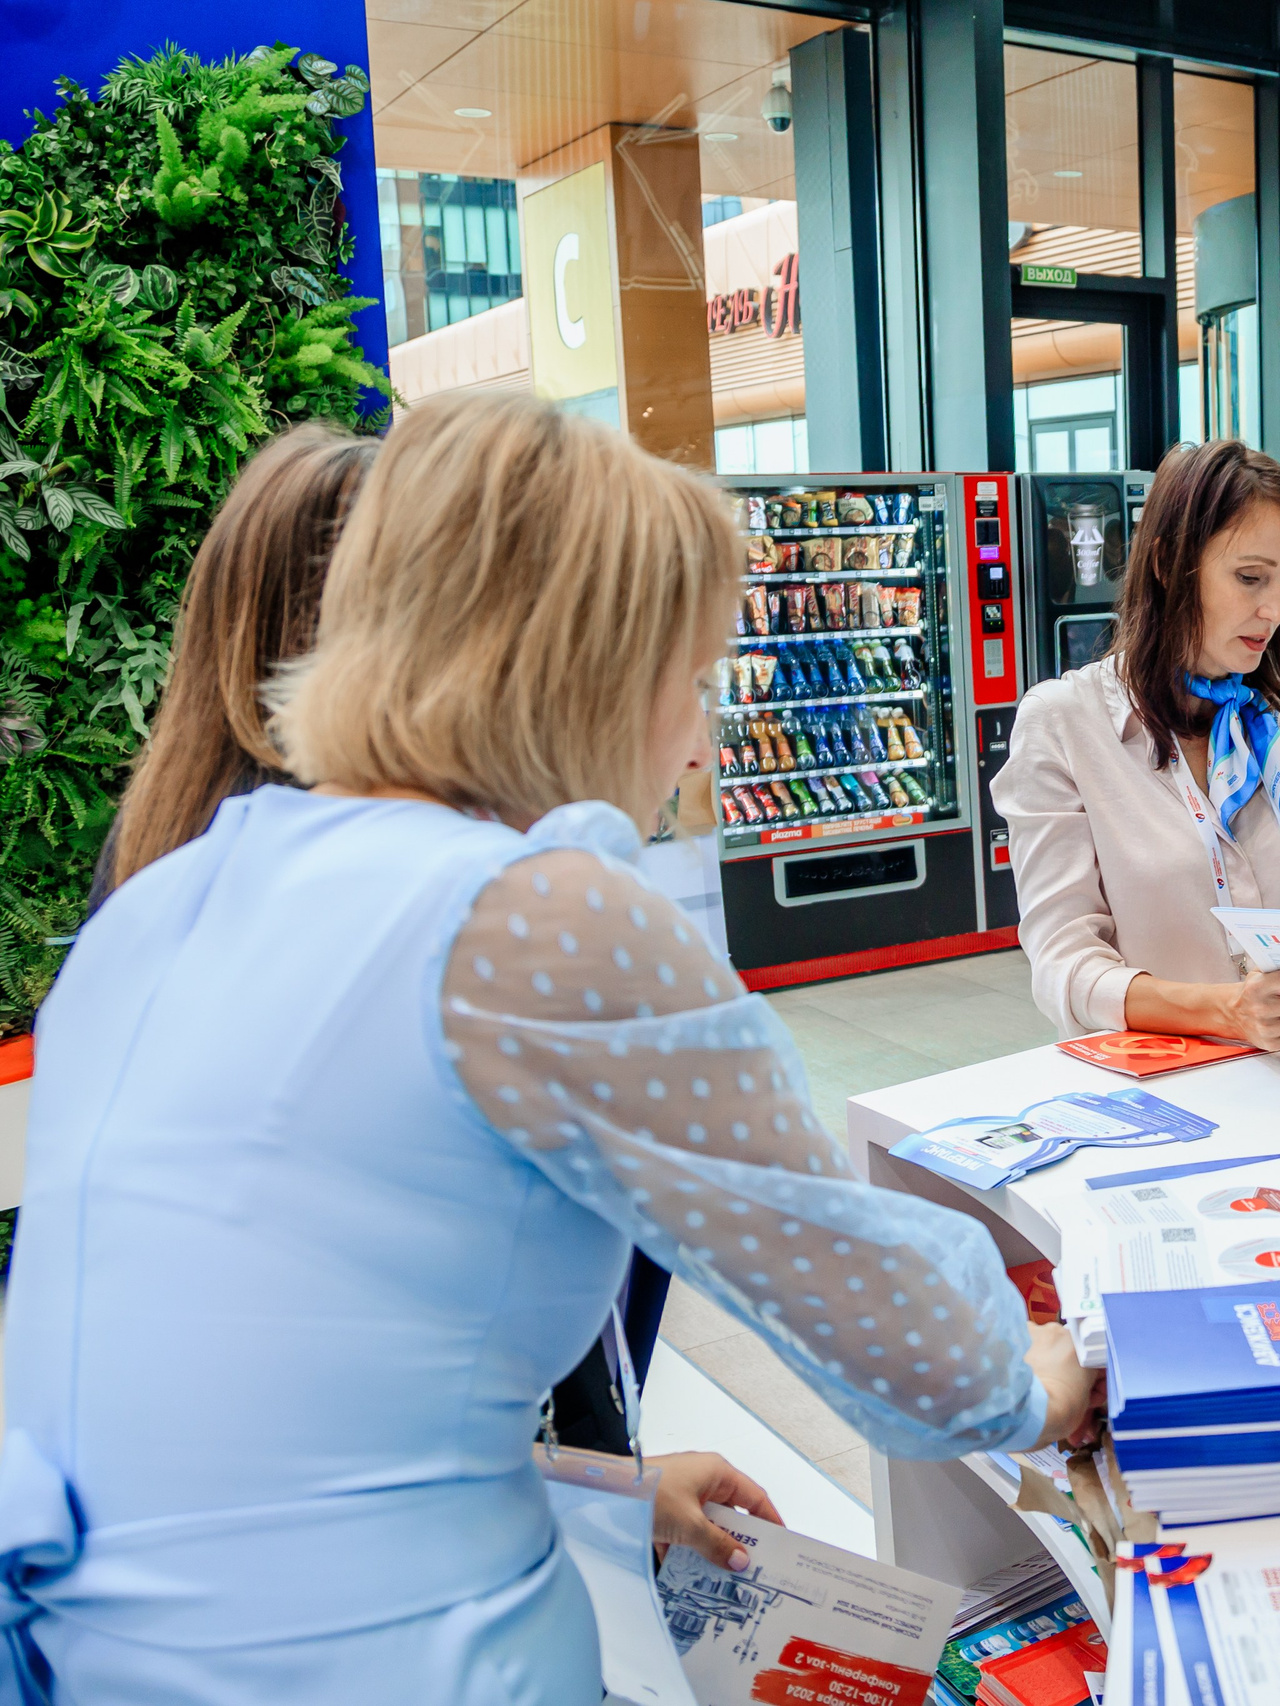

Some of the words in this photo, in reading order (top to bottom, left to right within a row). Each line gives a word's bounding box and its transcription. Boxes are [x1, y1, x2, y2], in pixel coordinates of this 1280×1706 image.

[1027, 267, 1072, 283] ВЫХОД
[771, 829, 802, 841] plazma
[794, 1652, 804, 1664] 2
[806, 1655, 901, 1696] Конференц-зал
[786, 1684, 808, 1699] 2024
